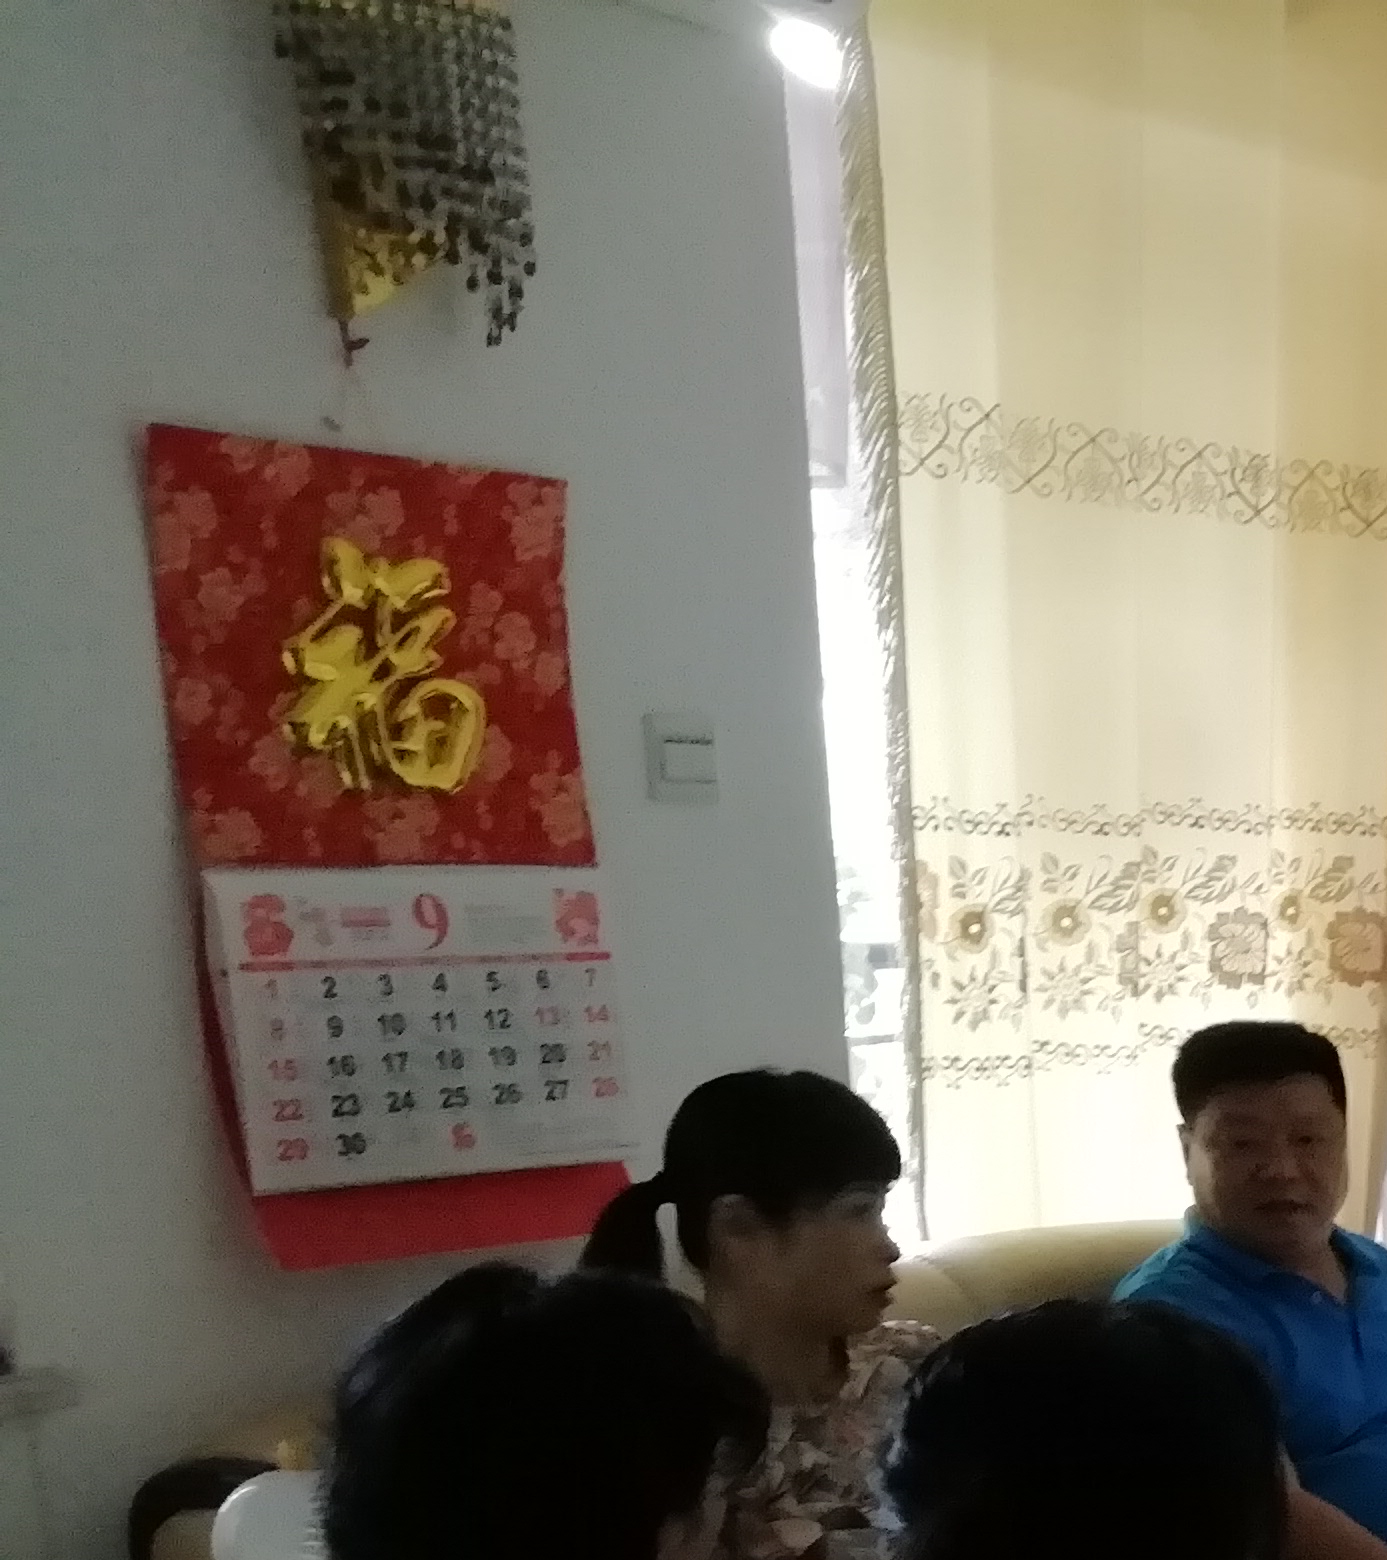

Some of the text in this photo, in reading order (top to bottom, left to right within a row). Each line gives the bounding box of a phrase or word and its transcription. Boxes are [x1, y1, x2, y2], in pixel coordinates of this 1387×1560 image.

[282, 537, 487, 796] 福
[413, 893, 450, 951] 9
[321, 976, 338, 999] 2
[376, 972, 394, 996] 3
[432, 972, 448, 992] 4
[486, 970, 502, 992] 5
[584, 968, 597, 987] 7
[326, 1014, 344, 1038] 9
[377, 1012, 407, 1036] 10
[431, 1009, 457, 1033] 11
[484, 1008, 513, 1030] 12
[268, 1058, 297, 1081] 15
[326, 1054, 357, 1078] 16
[381, 1050, 409, 1073] 17
[435, 1048, 465, 1070] 18
[488, 1045, 517, 1066] 19
[273, 1098, 304, 1122] 22
[331, 1093, 362, 1118] 23
[386, 1089, 416, 1114] 24
[439, 1086, 469, 1109] 25
[491, 1082, 523, 1105] 26
[544, 1079, 570, 1101] 27
